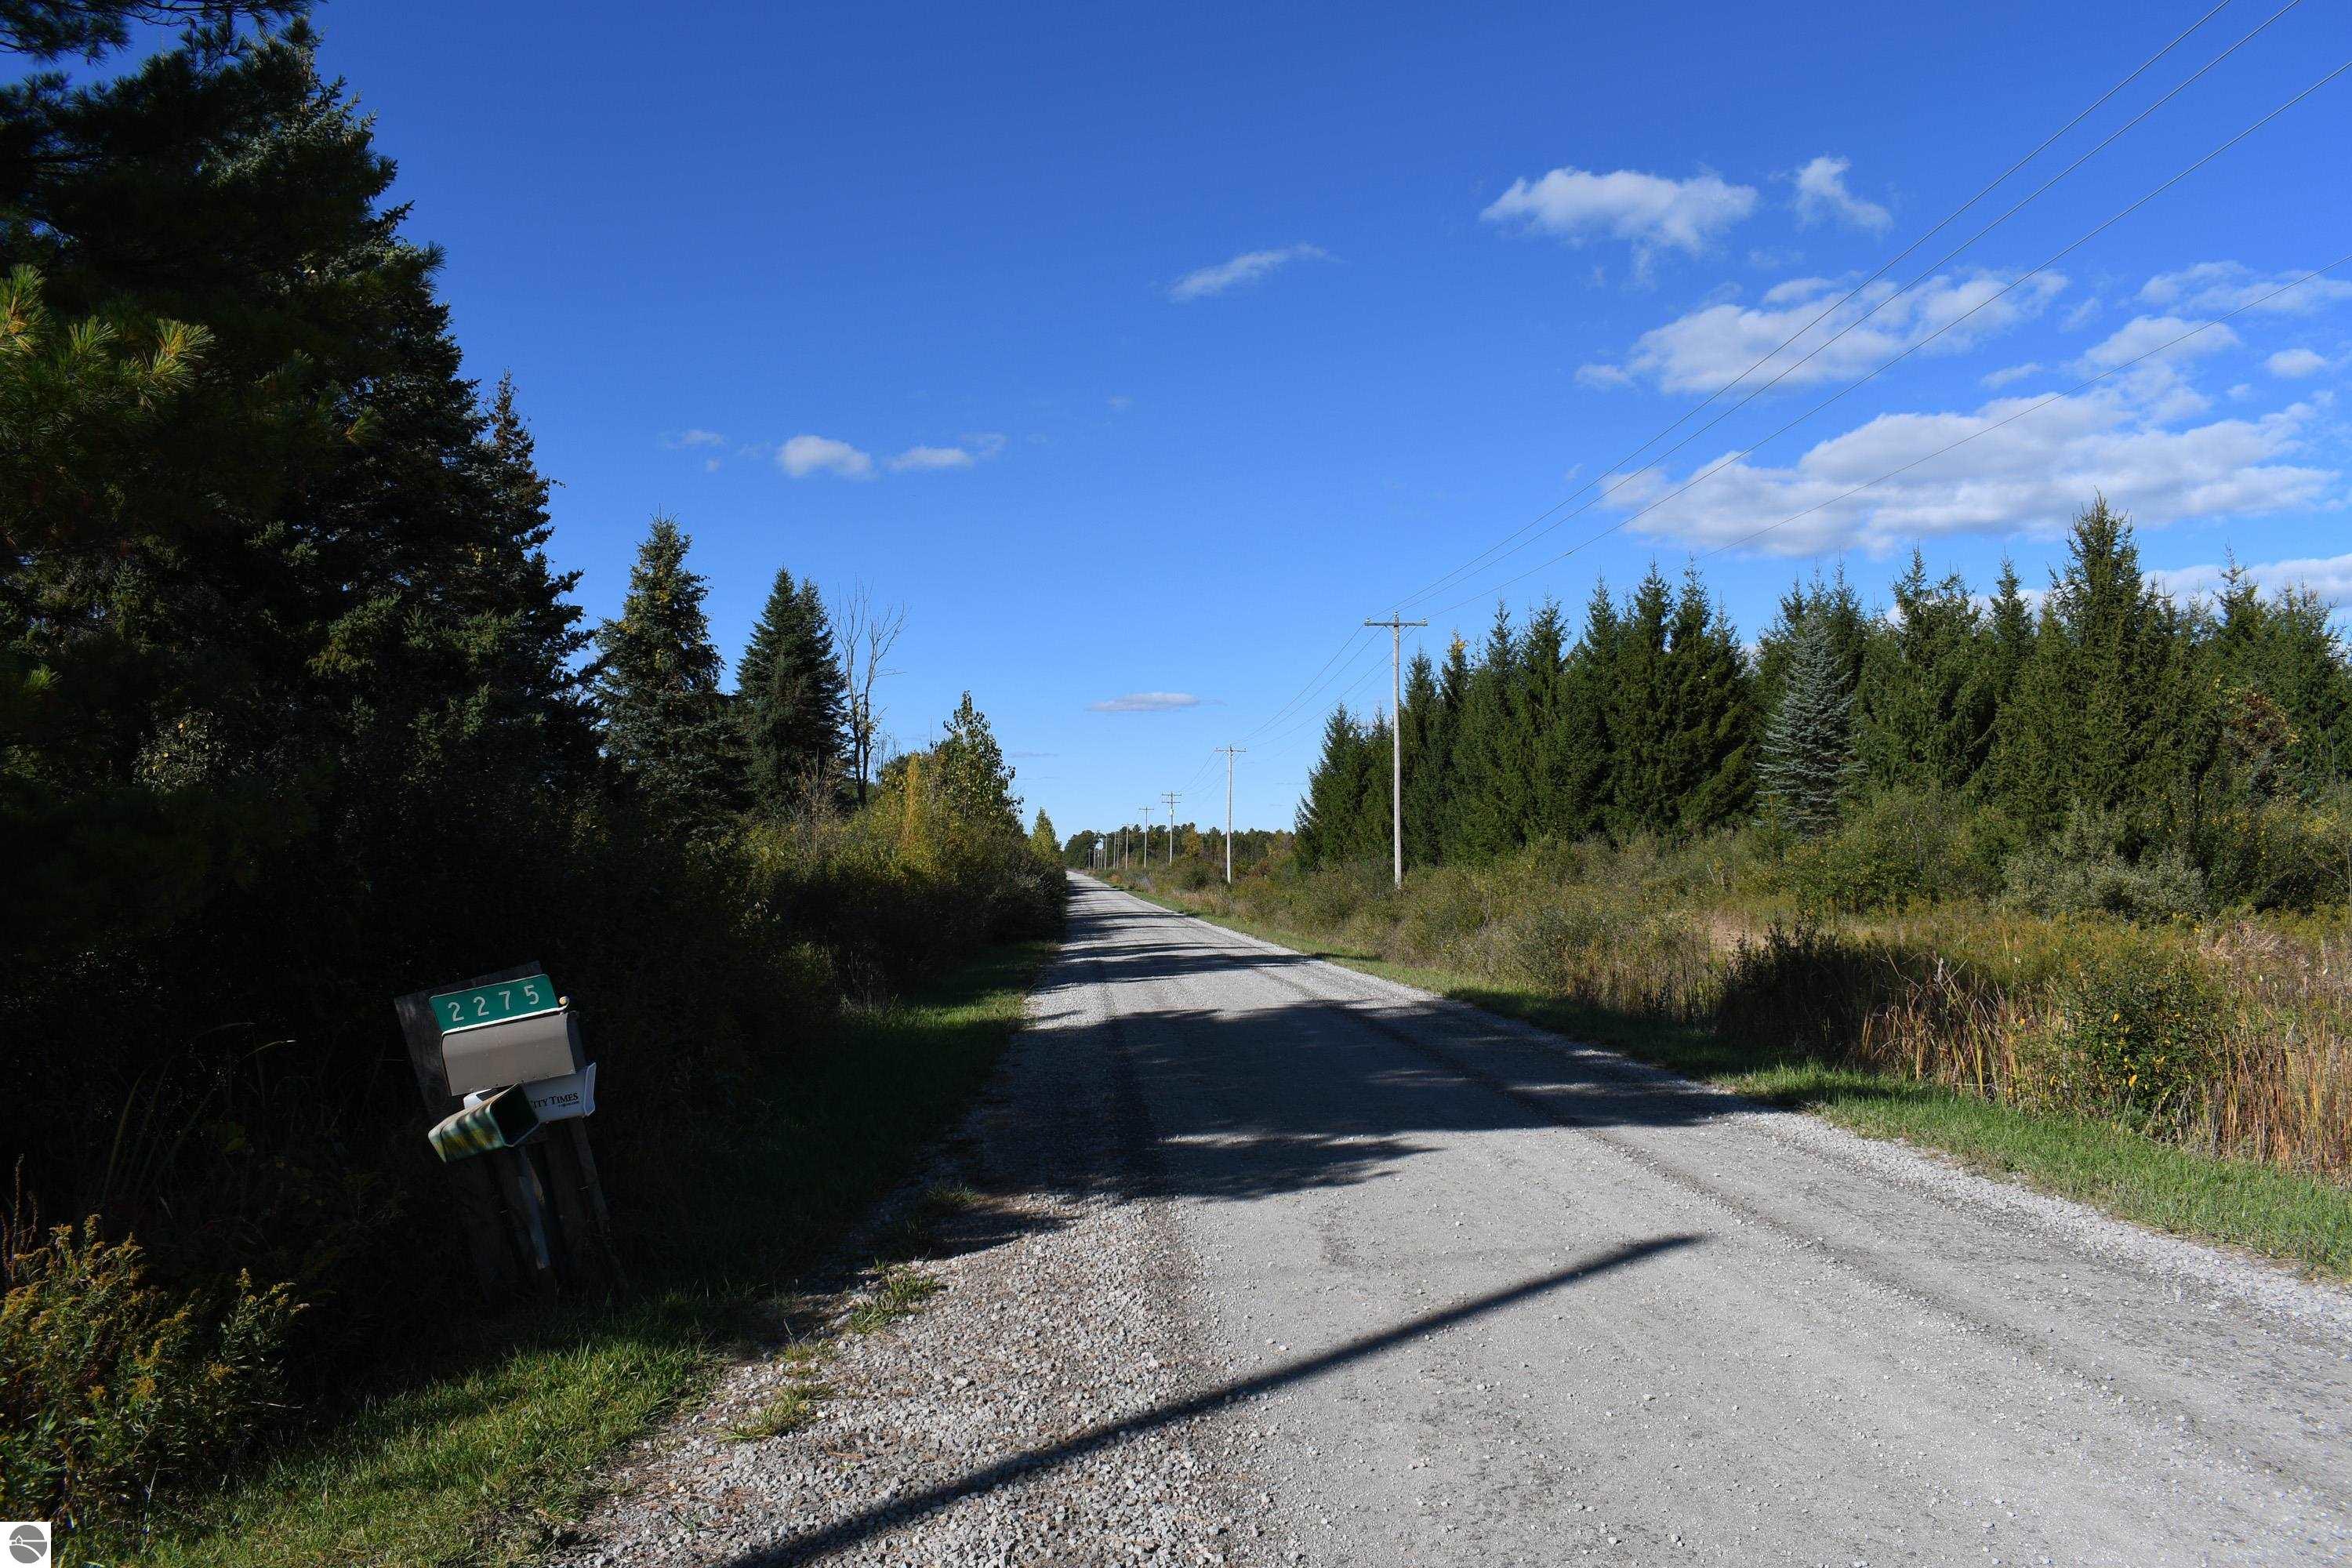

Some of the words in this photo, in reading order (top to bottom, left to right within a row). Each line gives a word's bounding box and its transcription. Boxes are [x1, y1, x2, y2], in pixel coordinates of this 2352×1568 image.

[448, 985, 539, 1022] 2275
[531, 1098, 548, 1109] ITY
[549, 1092, 579, 1105] TIMES
